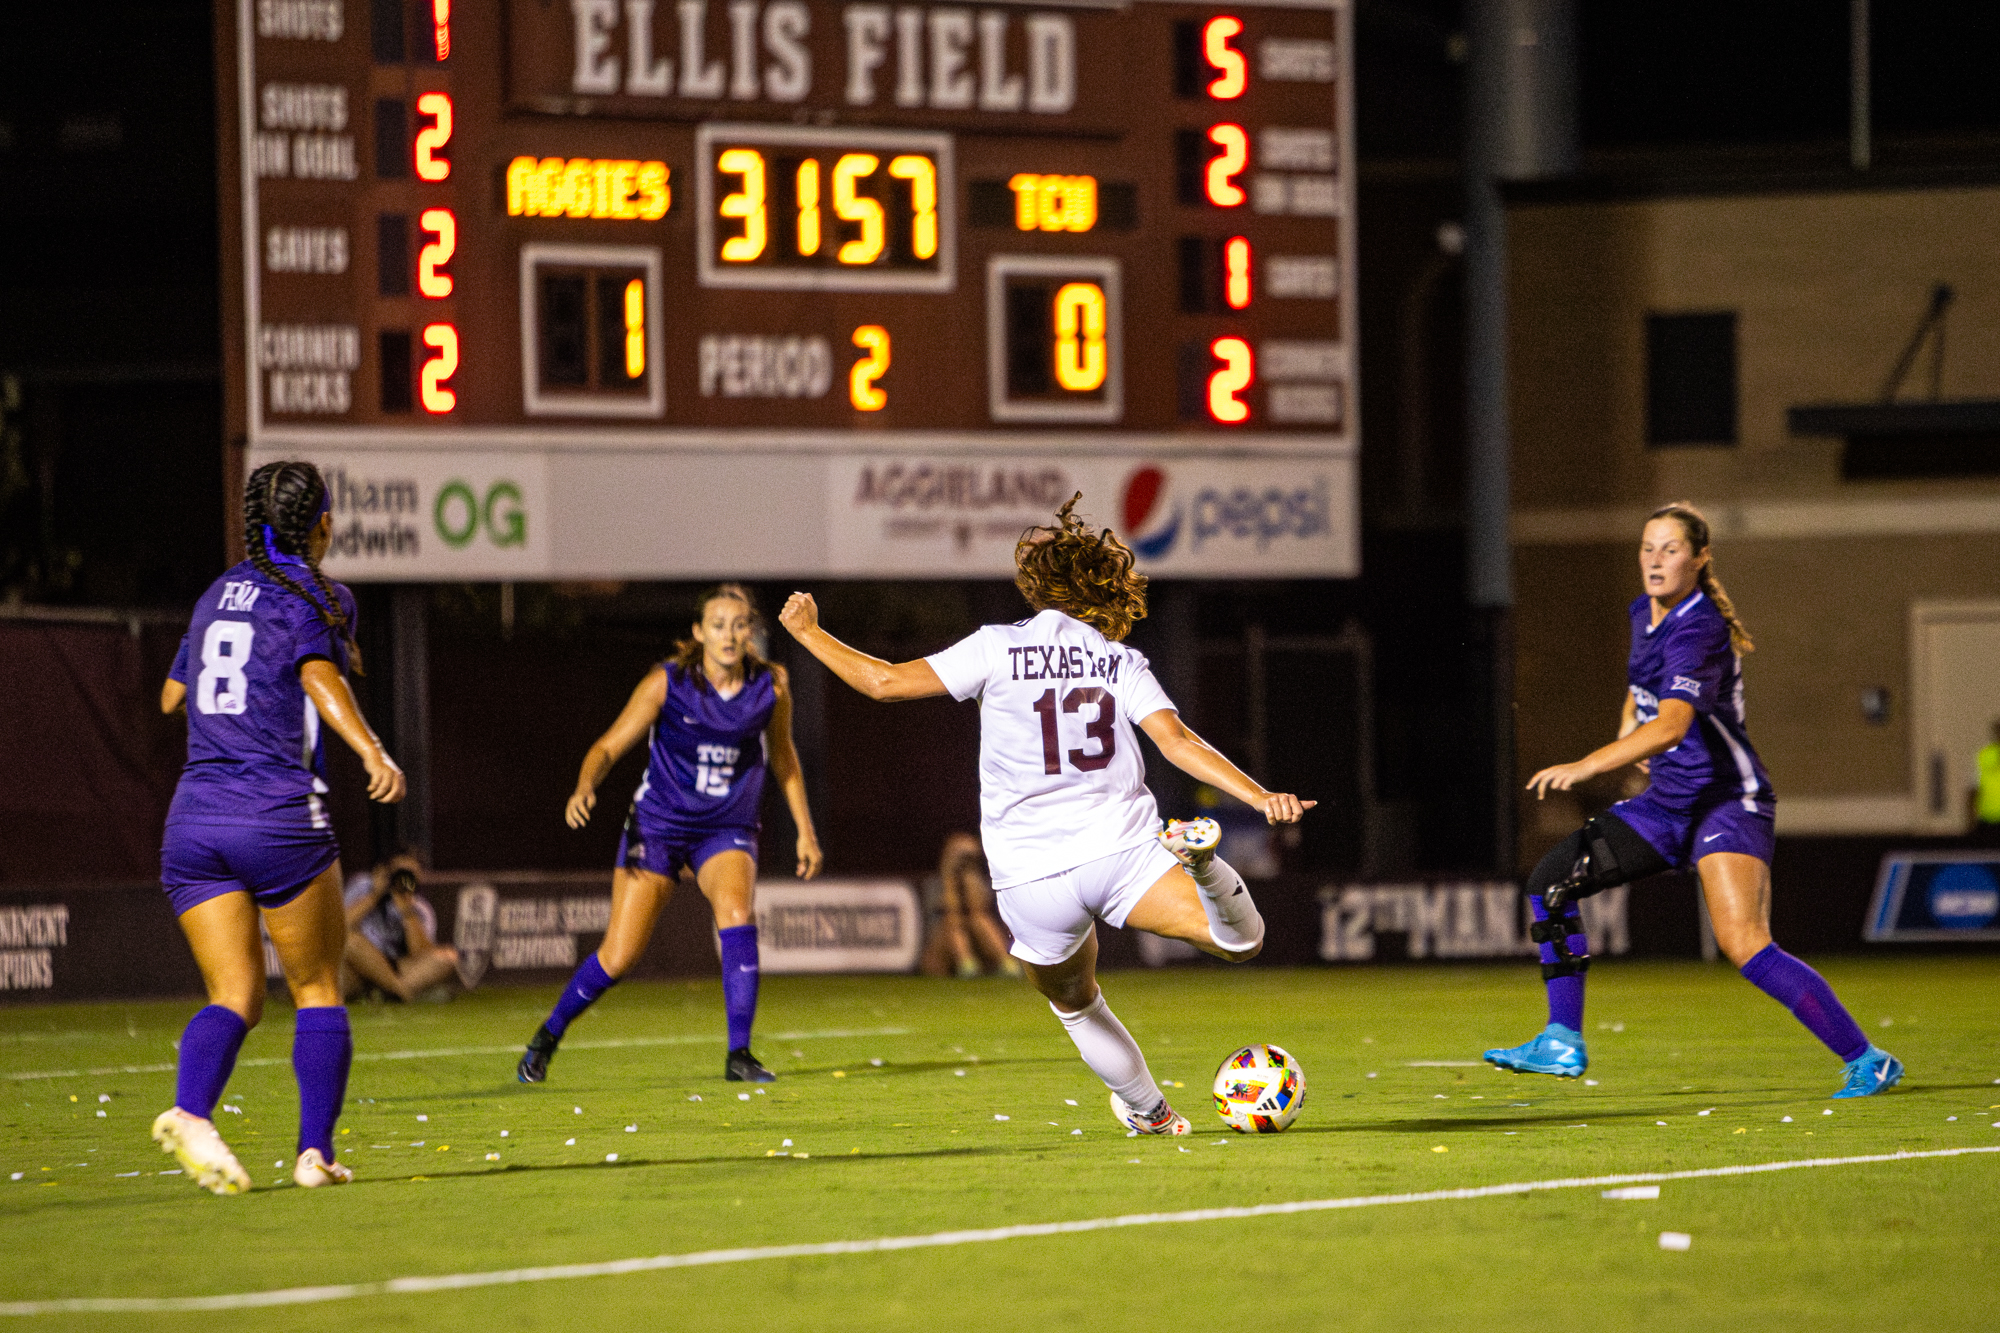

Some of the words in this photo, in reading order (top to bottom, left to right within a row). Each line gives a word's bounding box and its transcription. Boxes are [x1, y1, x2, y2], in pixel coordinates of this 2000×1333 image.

[573, 0, 812, 101] ELLIS
[843, 4, 1076, 113] FIELD
[1203, 15, 1249, 100] 5
[416, 91, 453, 183] 2
[1204, 122, 1250, 208] 2
[507, 156, 671, 220] AGGIES
[418, 208, 457, 299] 2
[1225, 235, 1251, 310] 1
[421, 322, 460, 414] 2
[624, 279, 646, 379] 1
[699, 333, 833, 400] PERIOD
[850, 324, 891, 412] 2
[1054, 282, 1107, 391] 0
[1208, 334, 1255, 425] 2
[434, 478, 528, 551] OG
[1190, 474, 1333, 555] pepsi
[197, 619, 255, 715] 8
[1008, 645, 1084, 681] TEXAS
[696, 743, 740, 765] TCU
[1033, 686, 1116, 775] 13
